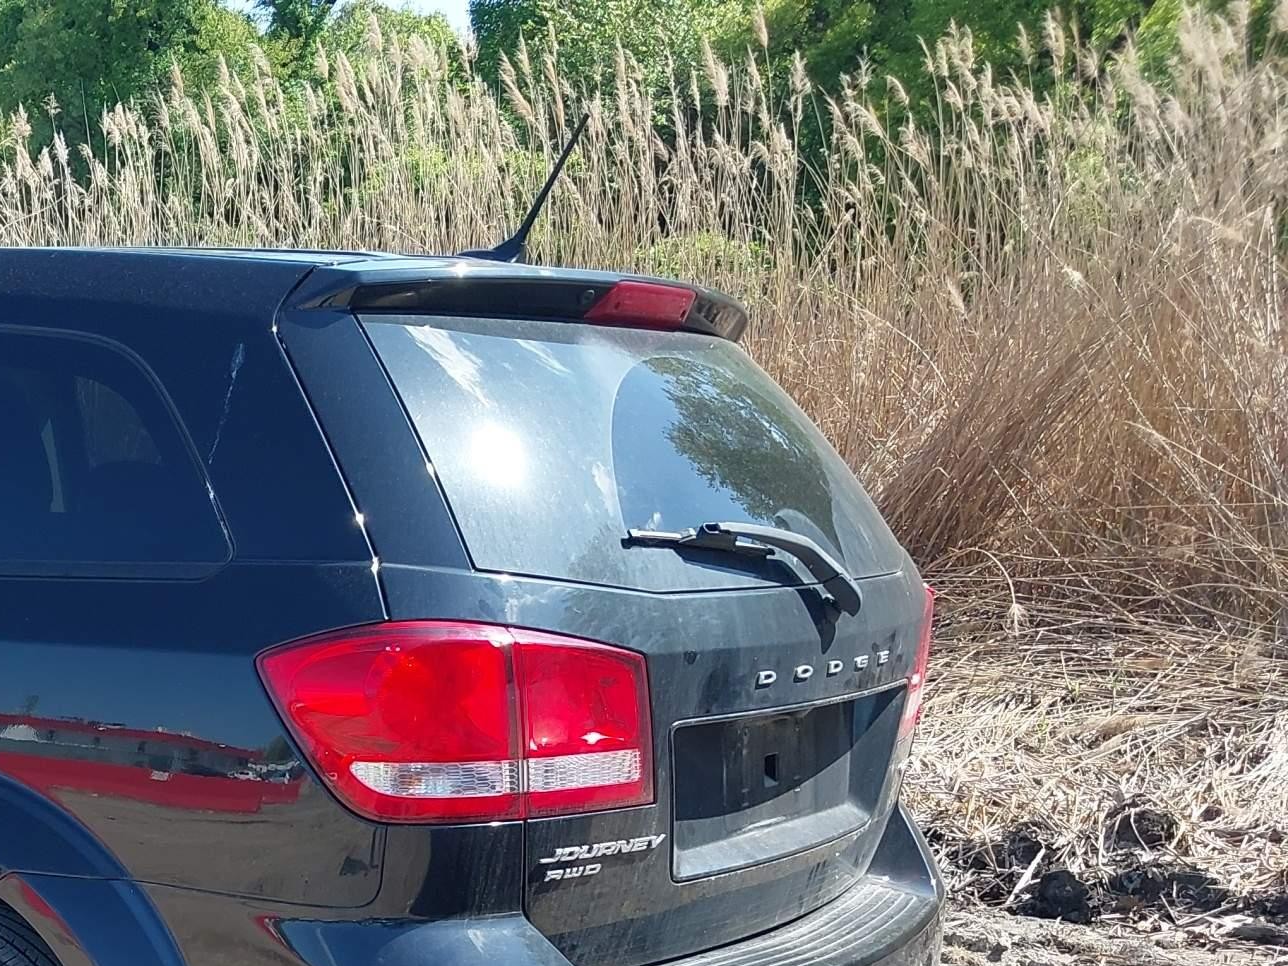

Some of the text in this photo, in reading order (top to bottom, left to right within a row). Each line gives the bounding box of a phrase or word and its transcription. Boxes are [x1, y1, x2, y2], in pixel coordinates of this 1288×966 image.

[757, 650, 890, 686] DODGE
[539, 833, 666, 864] JOURNEY
[544, 863, 602, 882] AWD
